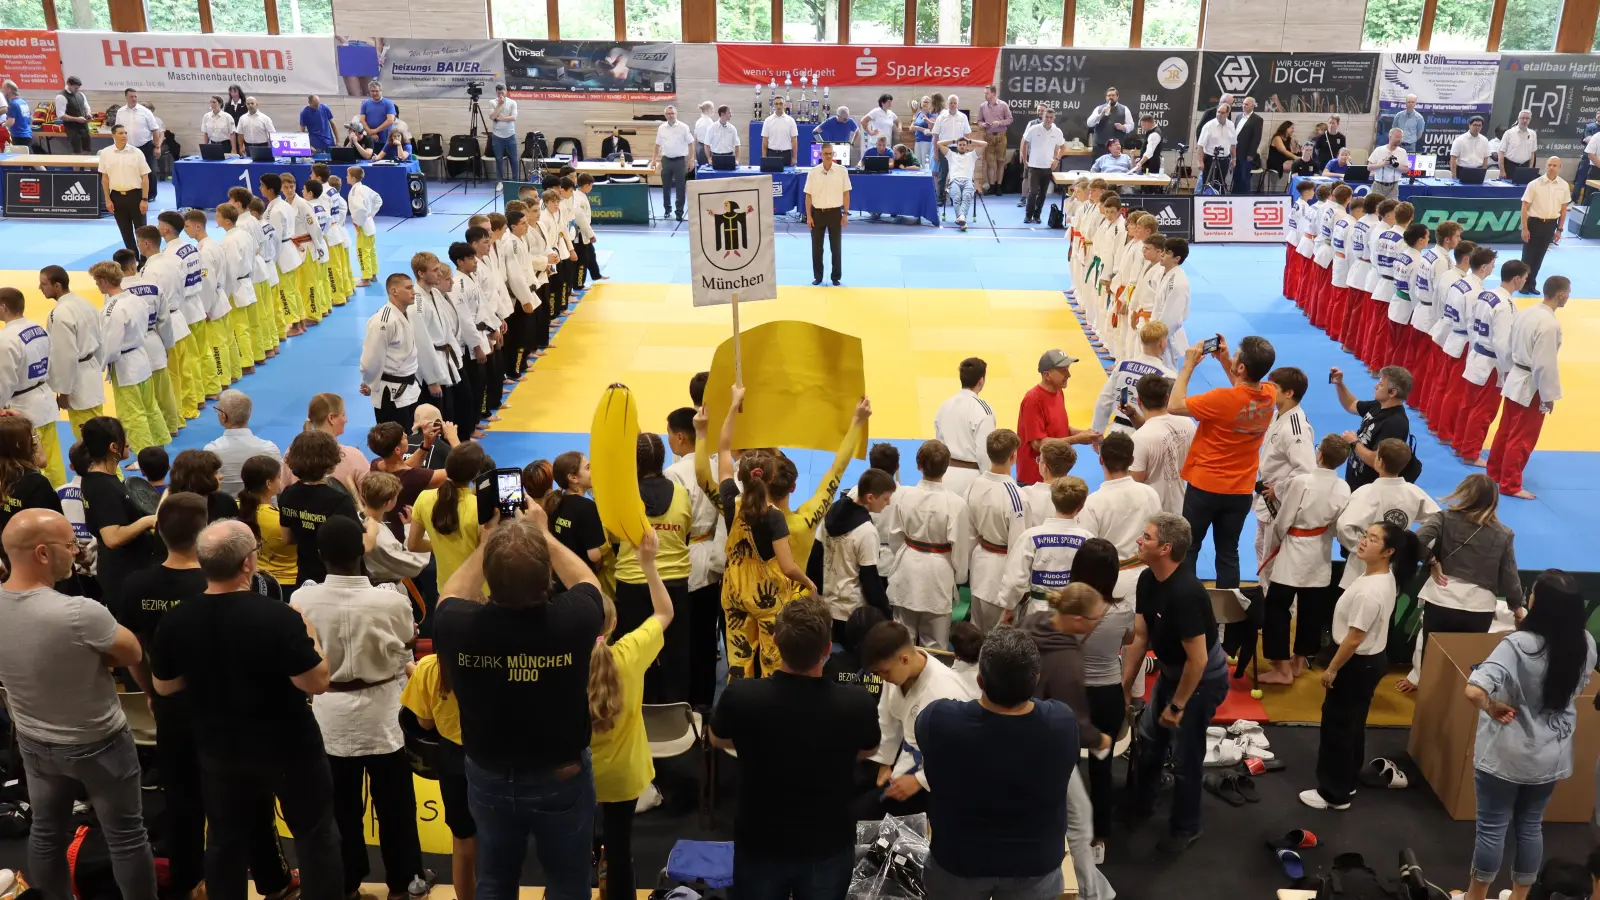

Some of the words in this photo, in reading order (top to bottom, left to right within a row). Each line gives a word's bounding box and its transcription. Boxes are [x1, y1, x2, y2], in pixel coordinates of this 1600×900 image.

[31, 38, 55, 47] Bau
[101, 40, 284, 70] Hermann
[632, 52, 669, 61] SELFSAT
[1395, 53, 1421, 65] RAPPL
[1424, 54, 1446, 65] Stein
[392, 63, 431, 73] heizungs
[436, 62, 480, 72] BAUER
[1009, 54, 1086, 72] MASSIV
[1293, 60, 1326, 68] SUCHEN
[743, 67, 774, 77] wenn's
[776, 69, 789, 77] um
[815, 68, 836, 78] geht
[886, 60, 971, 79] Sparkasse
[168, 72, 286, 84] Maschinenbautechnologie
[1274, 68, 1325, 84] DICH
[1007, 76, 1090, 94] GEBAUT
[1140, 94, 1158, 102] BAU
[1008, 99, 1031, 108] JOSEF
[1062, 101, 1081, 109] BAU
[61, 193, 91, 201] adidas
[1157, 217, 1182, 226] didas
[702, 272, 764, 290] München
[1125, 377, 1139, 387] GE
[282, 507, 299, 518] BEZIRK
[299, 511, 327, 523] MÜNCHEN
[652, 523, 681, 531] ZUKI
[1037, 536, 1059, 544] RAPHAEL
[141, 599, 168, 612] BEZIRK
[458, 653, 503, 668] BEZIRK
[507, 653, 573, 668] MÜNCHEN
[507, 669, 539, 682] JUDO
